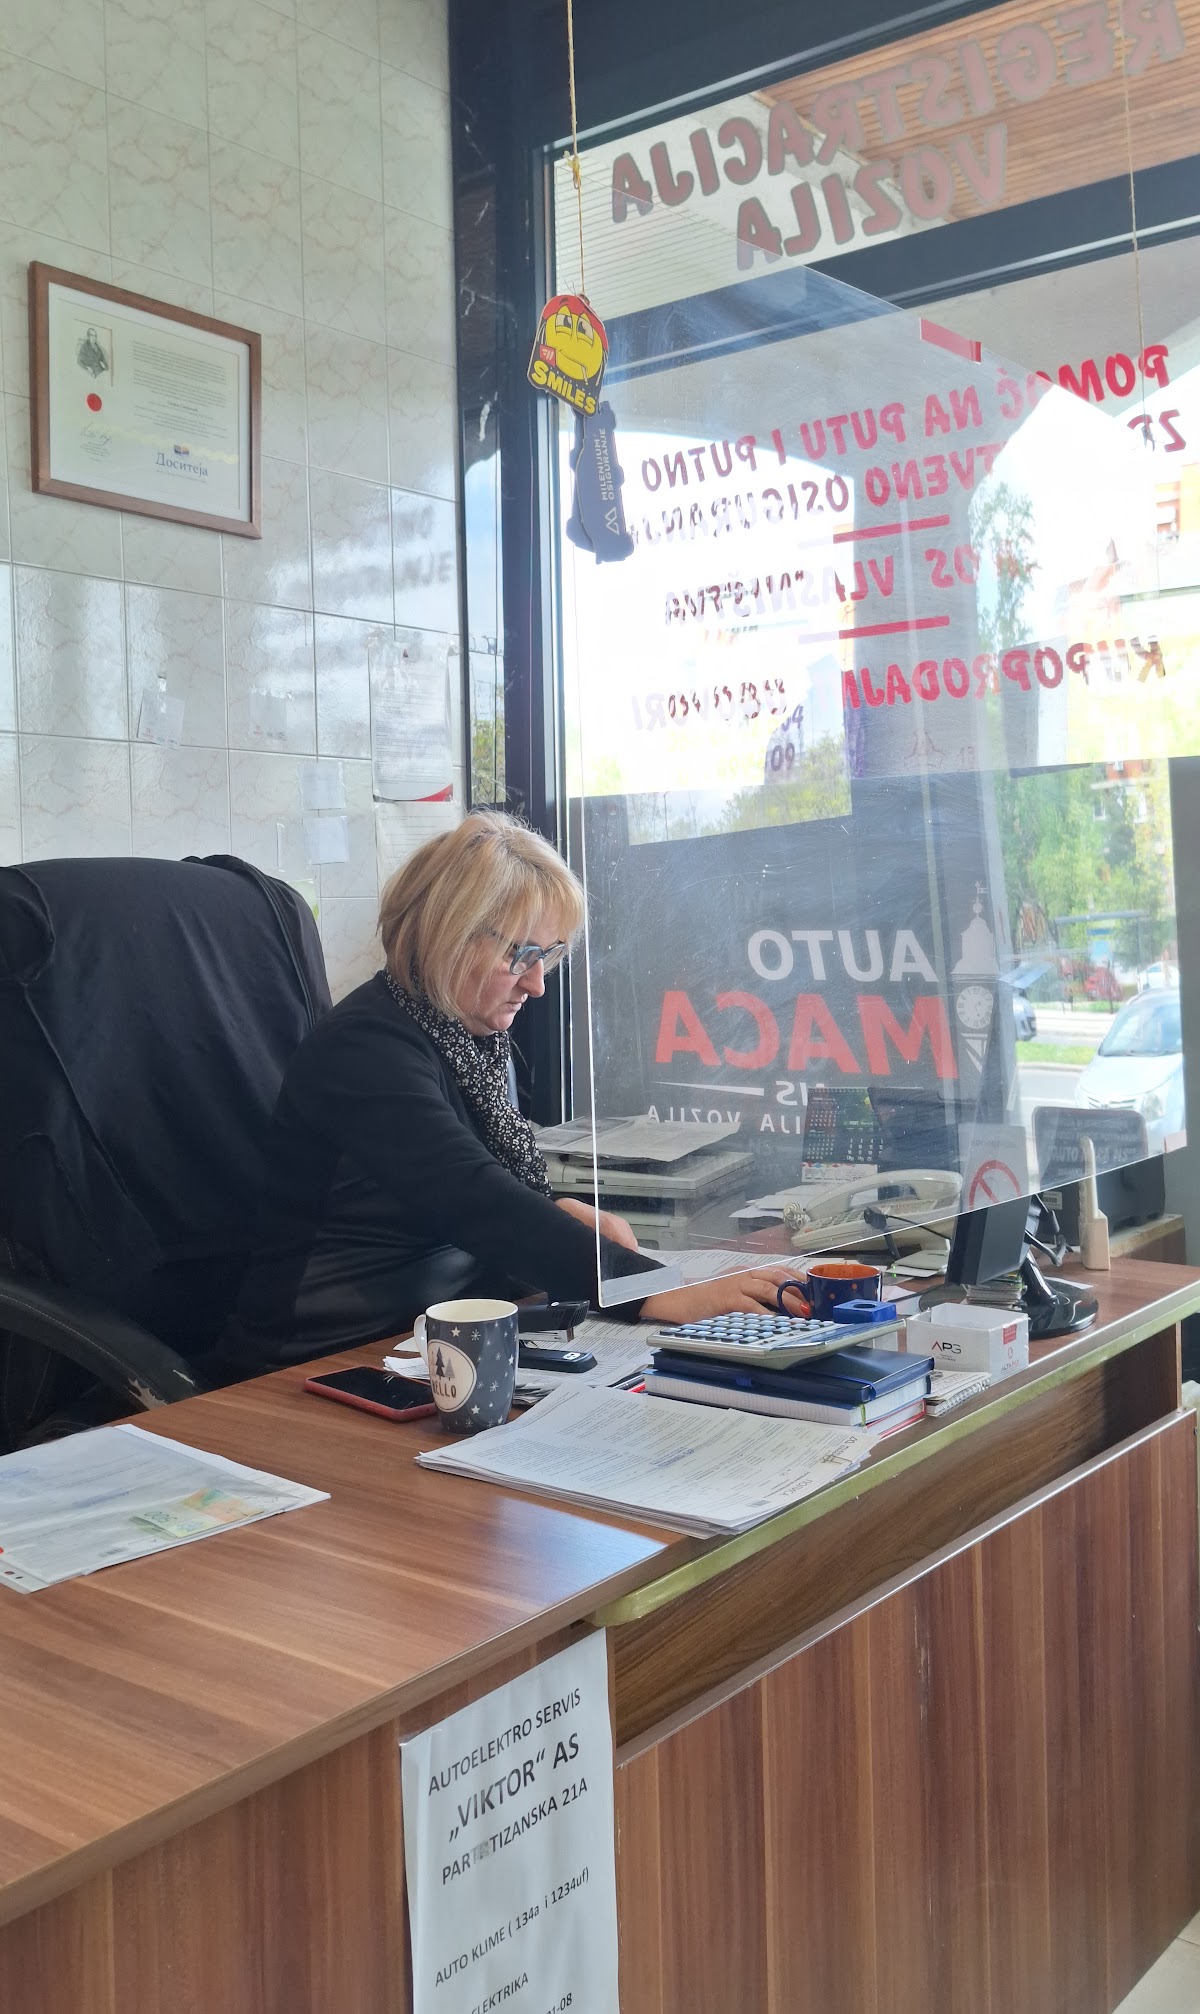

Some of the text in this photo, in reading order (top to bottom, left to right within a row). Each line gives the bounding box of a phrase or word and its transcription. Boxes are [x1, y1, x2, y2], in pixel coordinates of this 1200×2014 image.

[531, 360, 597, 414] SMILES
[156, 453, 208, 477] Доситеја
[594, 438, 609, 501] MILENIJUM
[599, 428, 615, 500] OSIGURANJE
[428, 1687, 582, 1796] AUTOELEKTRO SERVIS
[552, 1732, 580, 1770] AS
[562, 1776, 588, 1808] 21A
[435, 1953, 468, 1988] AUTO
[472, 1927, 506, 1965] KLIME
